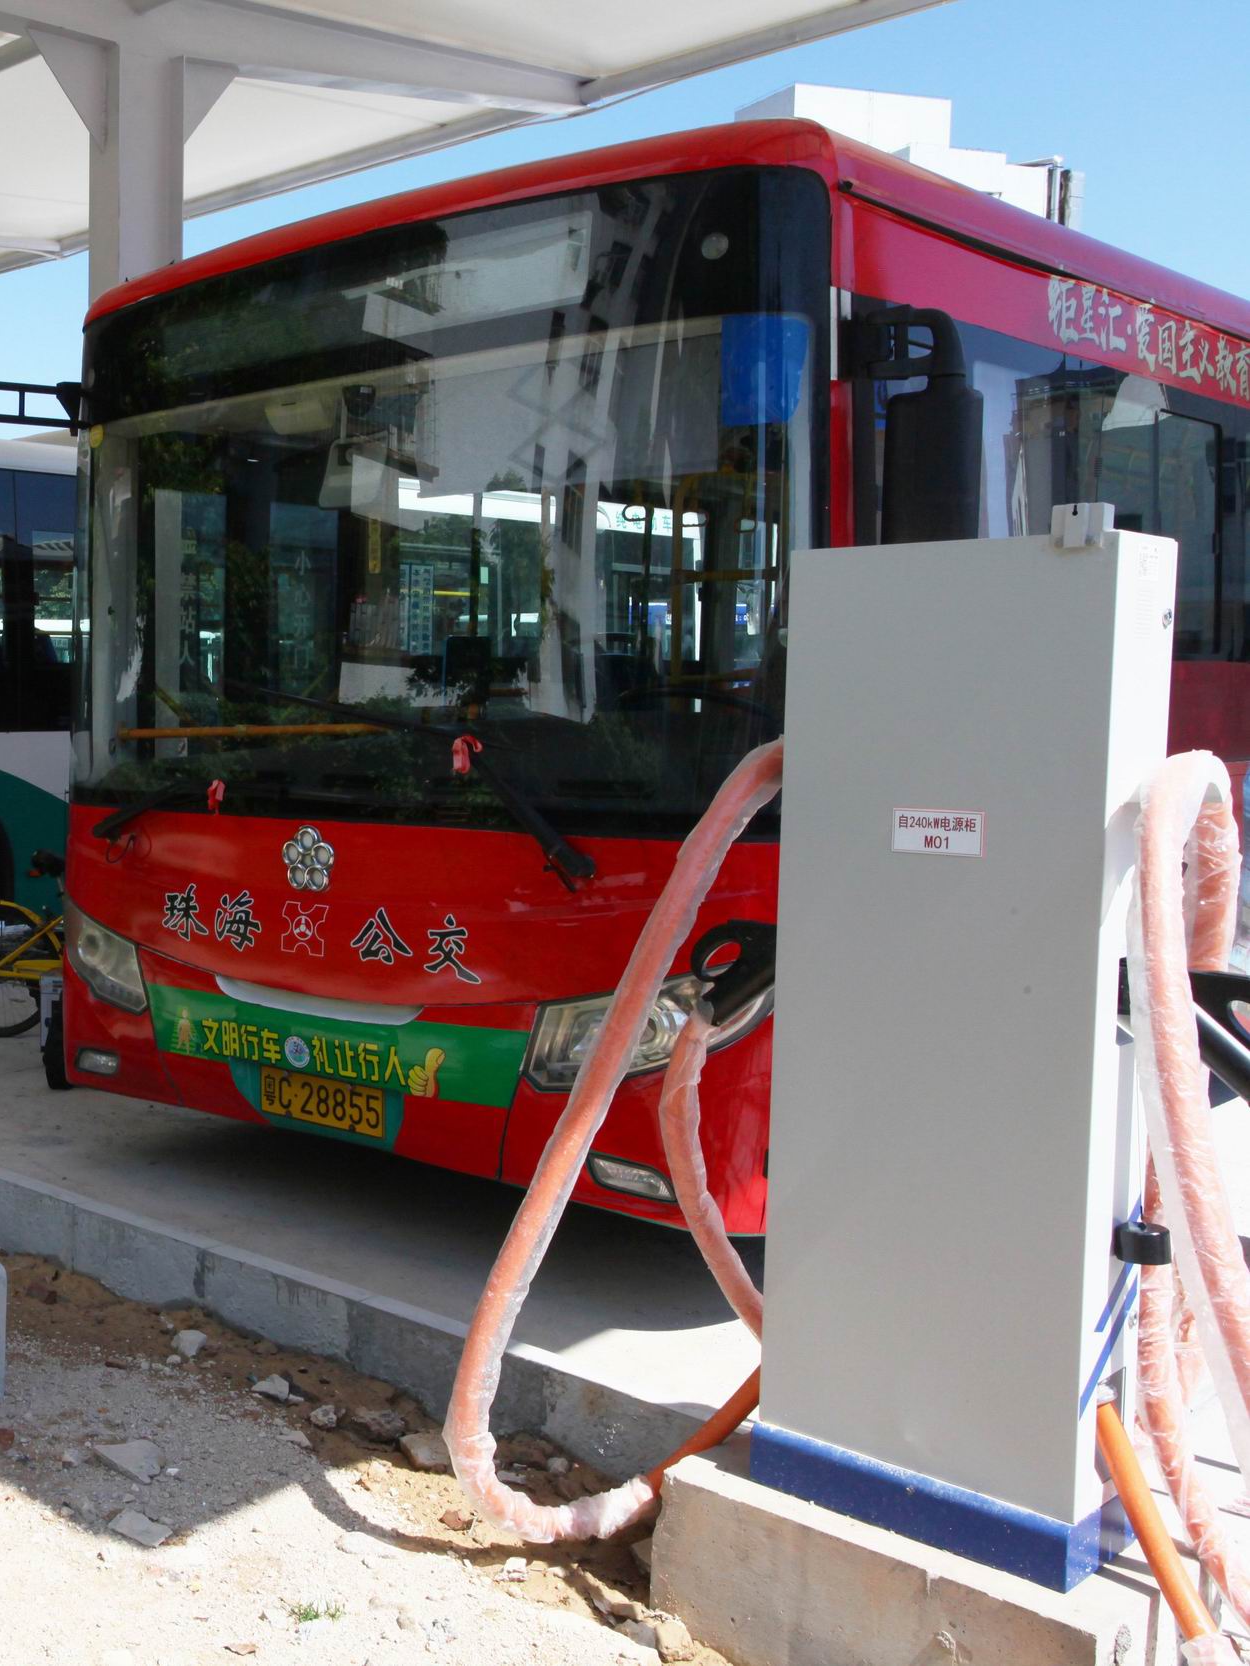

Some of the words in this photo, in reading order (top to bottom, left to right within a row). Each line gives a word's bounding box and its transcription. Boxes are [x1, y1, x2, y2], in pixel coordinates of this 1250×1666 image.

[898, 814, 977, 833] 自240kW电源柜
[202, 1018, 282, 1065] 文明行车
[311, 1035, 407, 1088] 礼让行人
